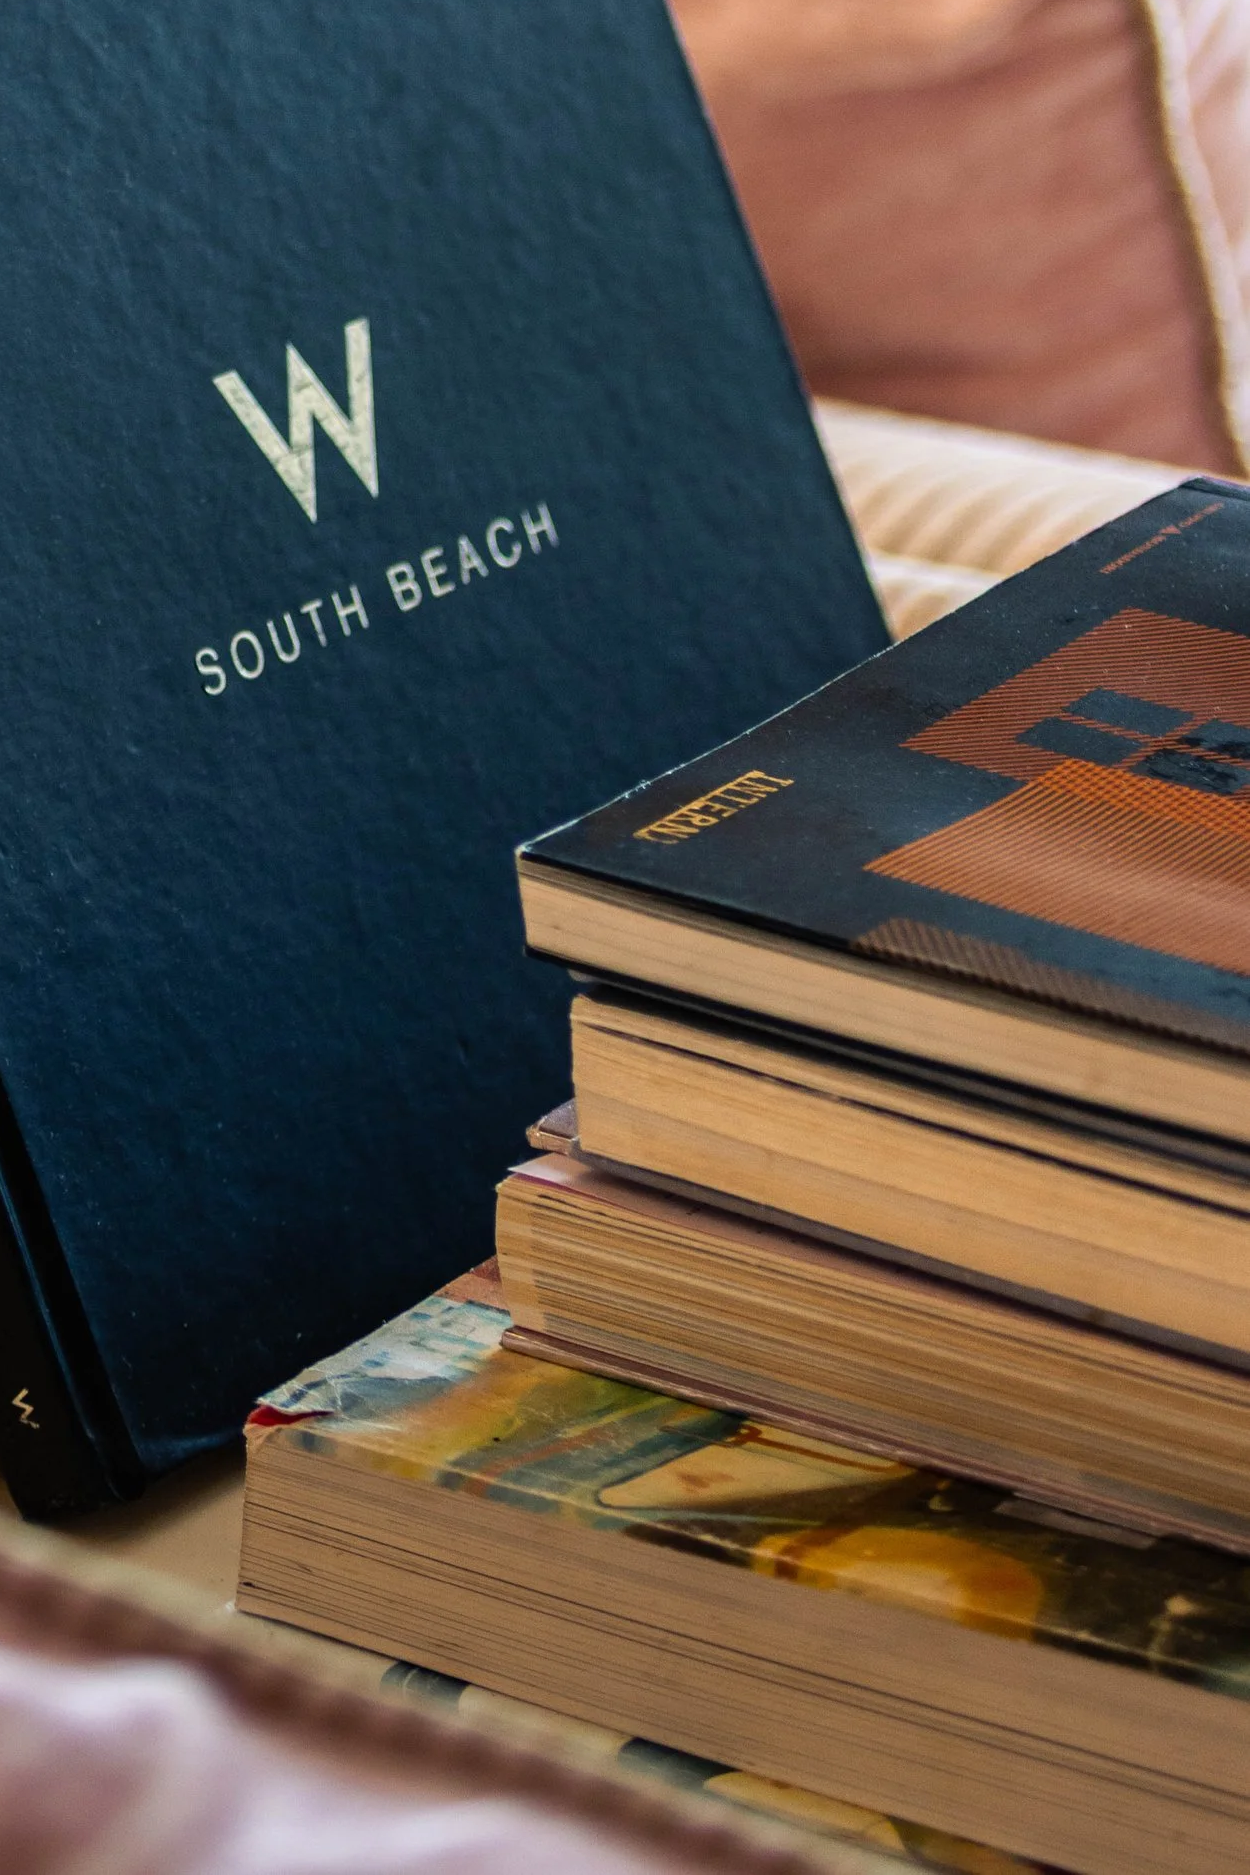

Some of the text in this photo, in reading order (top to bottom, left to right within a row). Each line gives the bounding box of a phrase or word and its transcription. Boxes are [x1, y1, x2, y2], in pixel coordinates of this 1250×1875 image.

[213, 319, 378, 522] W
[195, 503, 559, 696] SOUTH BEACH
